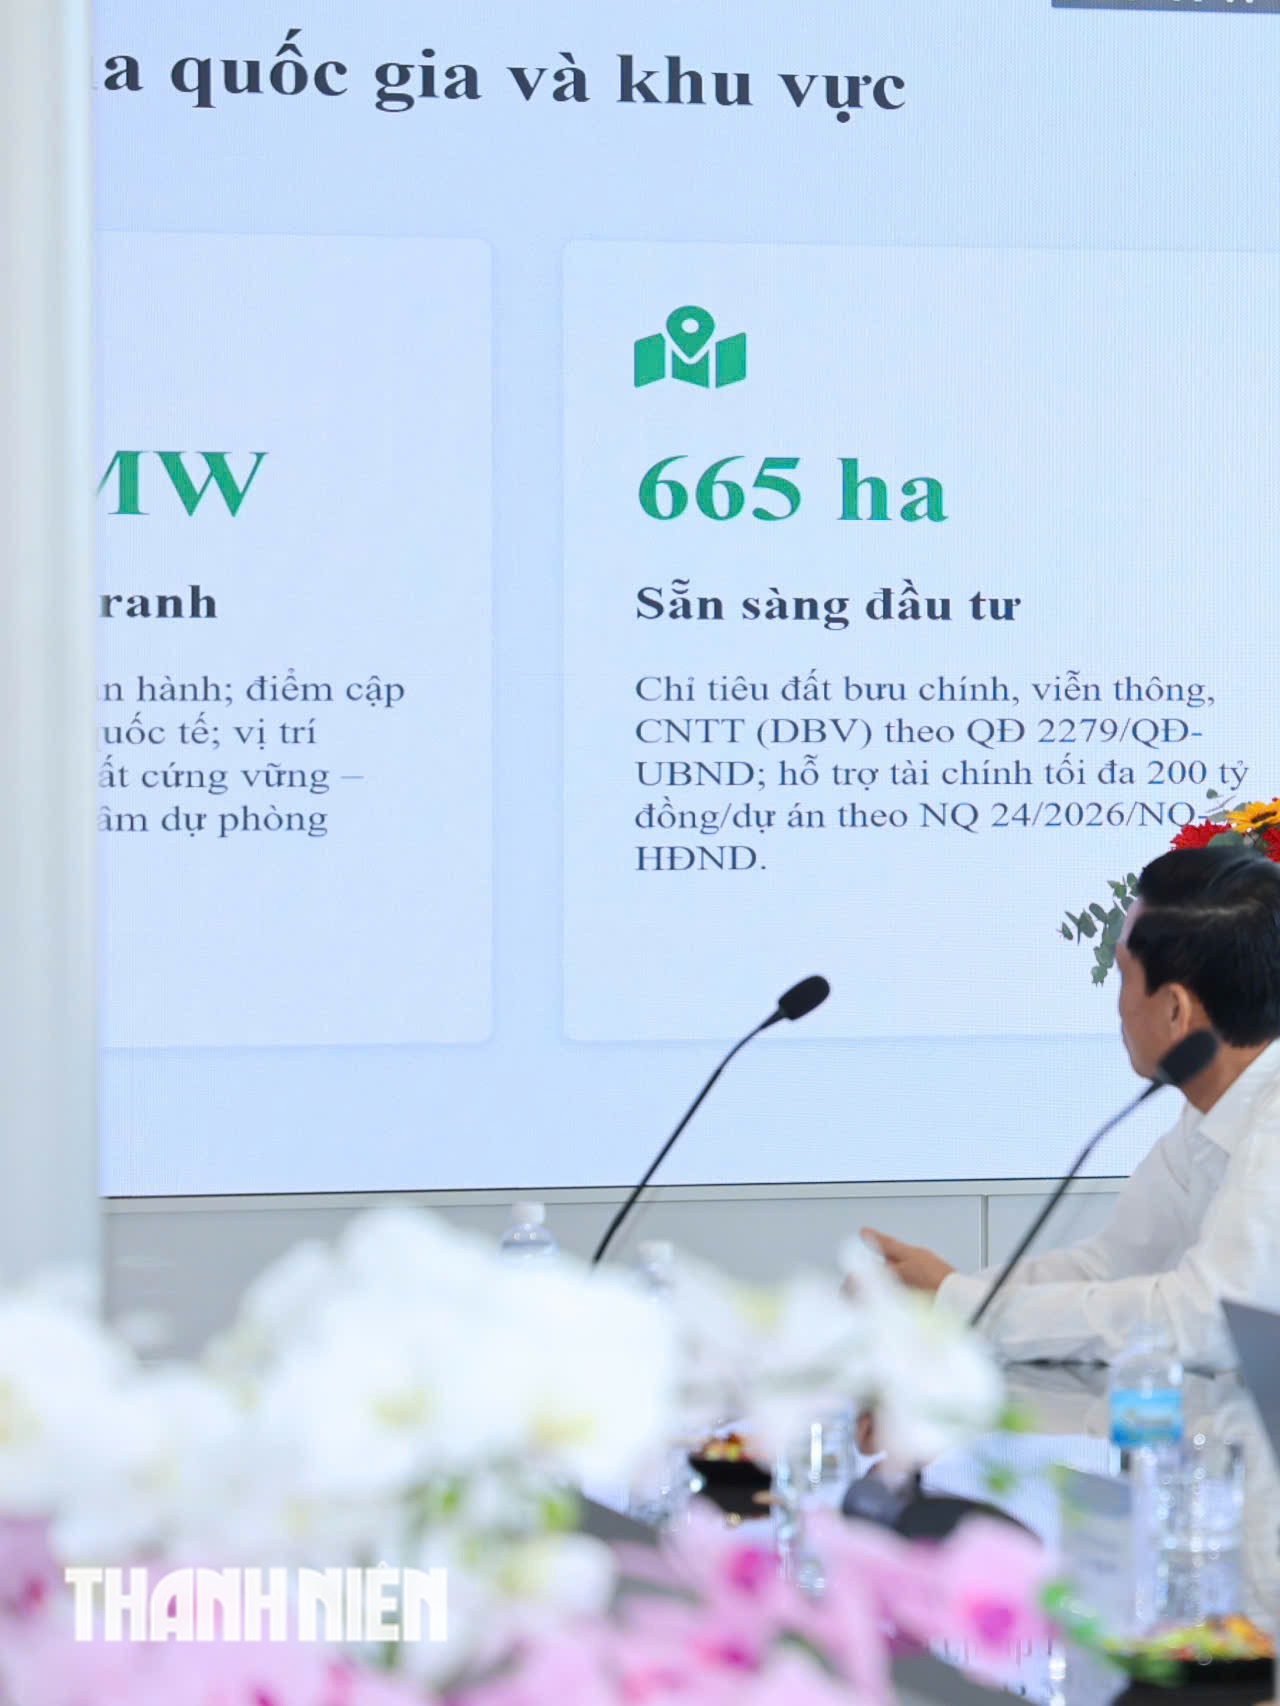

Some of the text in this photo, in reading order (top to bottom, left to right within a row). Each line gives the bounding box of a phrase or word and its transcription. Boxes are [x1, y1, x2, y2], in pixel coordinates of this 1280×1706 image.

[93, 28, 906, 124] a quốc gia và khu vực
[637, 455, 950, 524] 665 ha
[636, 578, 1022, 631] Sẵn sàng đầu tư
[136, 675, 233, 706] hành;
[245, 667, 334, 702] điểm
[345, 674, 406, 709] cập
[635, 668, 1215, 709] Chỉ tiêu đất bưu chính, viễn thông,
[98, 711, 317, 751] uốc tế; vị trí
[635, 717, 1203, 750] CNTT (DBV) theo QĐ 2279/QĐ-
[140, 761, 229, 796] cứng
[240, 762, 330, 795] vững
[635, 752, 1250, 795] UBND; hỗ trợ tài chính tối đa 200 tỷ
[160, 805, 207, 838] dự
[218, 804, 328, 839] phòng
[634, 795, 777, 836] đồng/dự
[787, 802, 826, 829] án
[837, 801, 909, 828] theo
[919, 802, 979, 834] NQ
[635, 845, 767, 871] HĐND.
